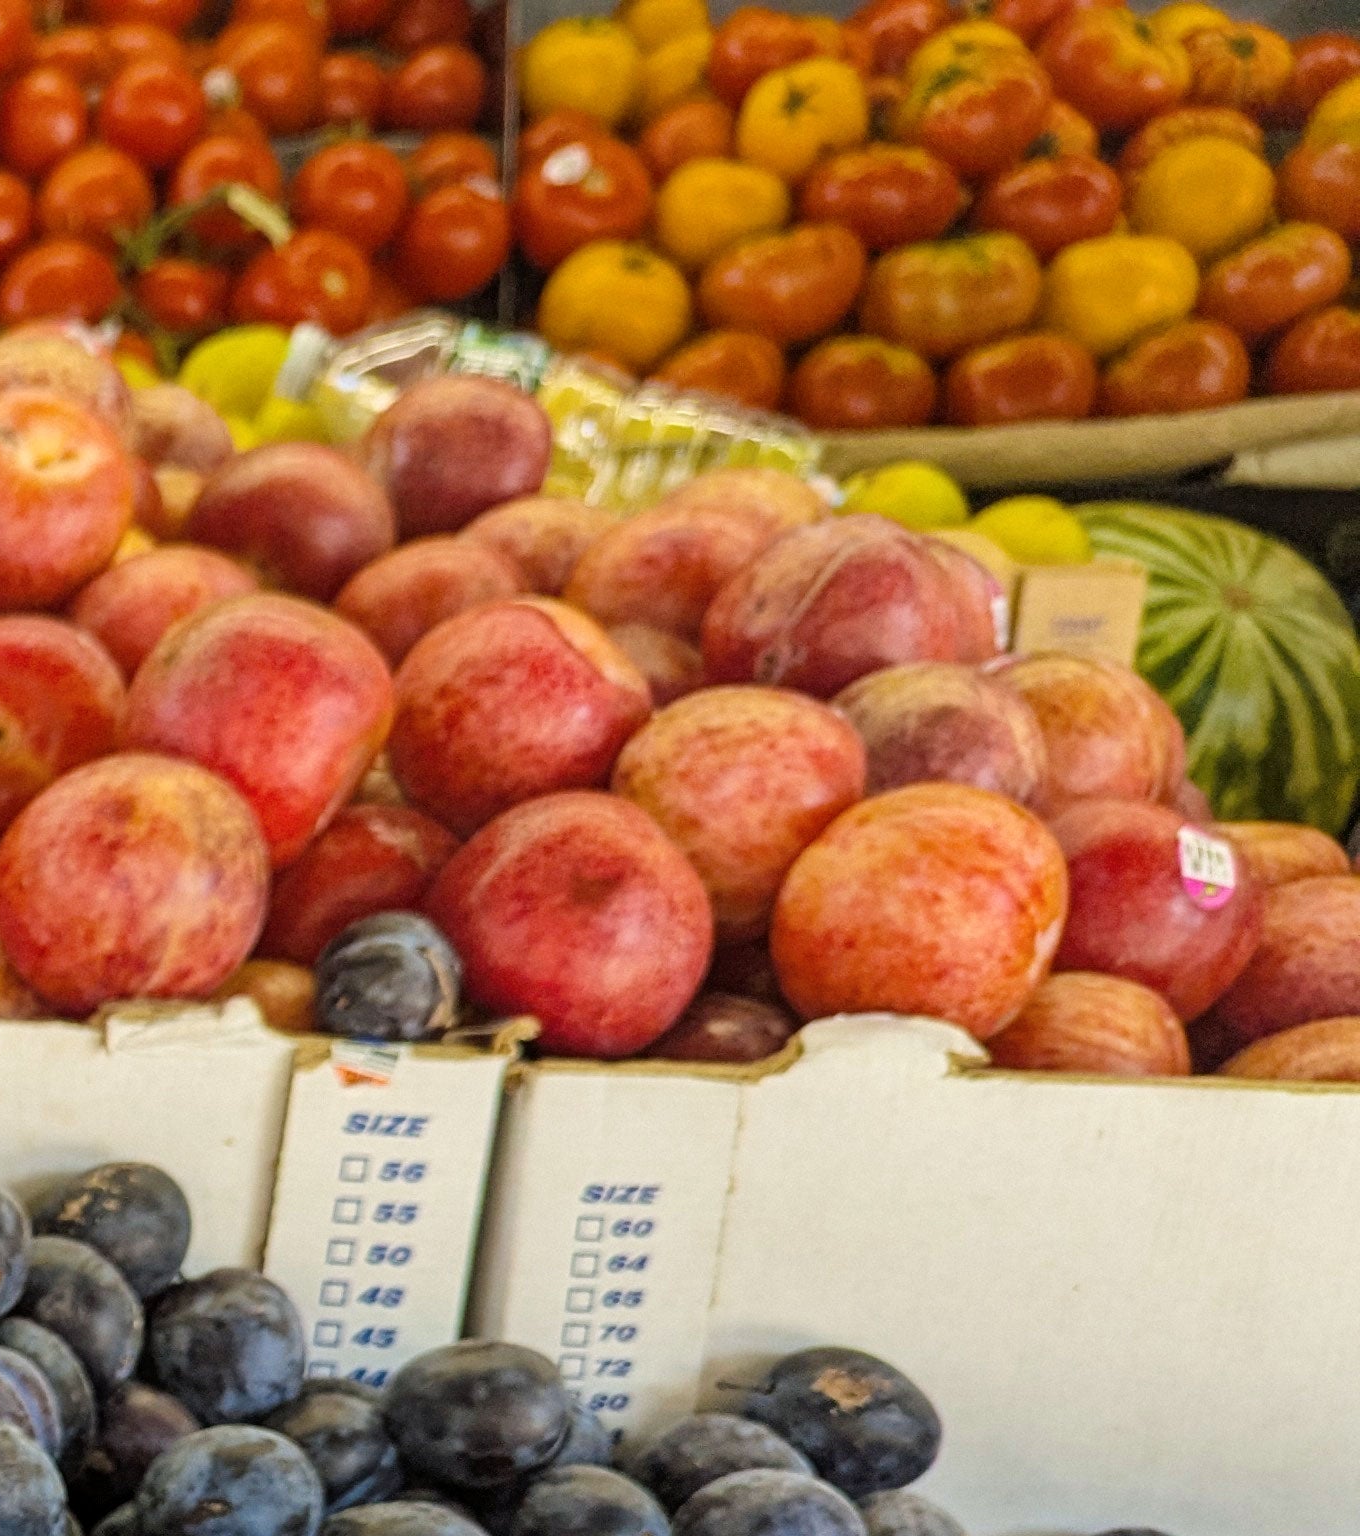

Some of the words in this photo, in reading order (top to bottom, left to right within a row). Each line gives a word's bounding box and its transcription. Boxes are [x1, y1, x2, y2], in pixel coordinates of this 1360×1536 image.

[343, 1112, 430, 1138] SIZE
[378, 1161, 426, 1182] 56
[580, 1183, 661, 1205] SIZE
[371, 1204, 419, 1224] 55
[611, 1219, 654, 1238] 60
[365, 1246, 412, 1265] 50
[606, 1254, 649, 1273] 64
[357, 1287, 404, 1307] 48
[351, 1328, 397, 1348] 45
[599, 1325, 638, 1343] 70
